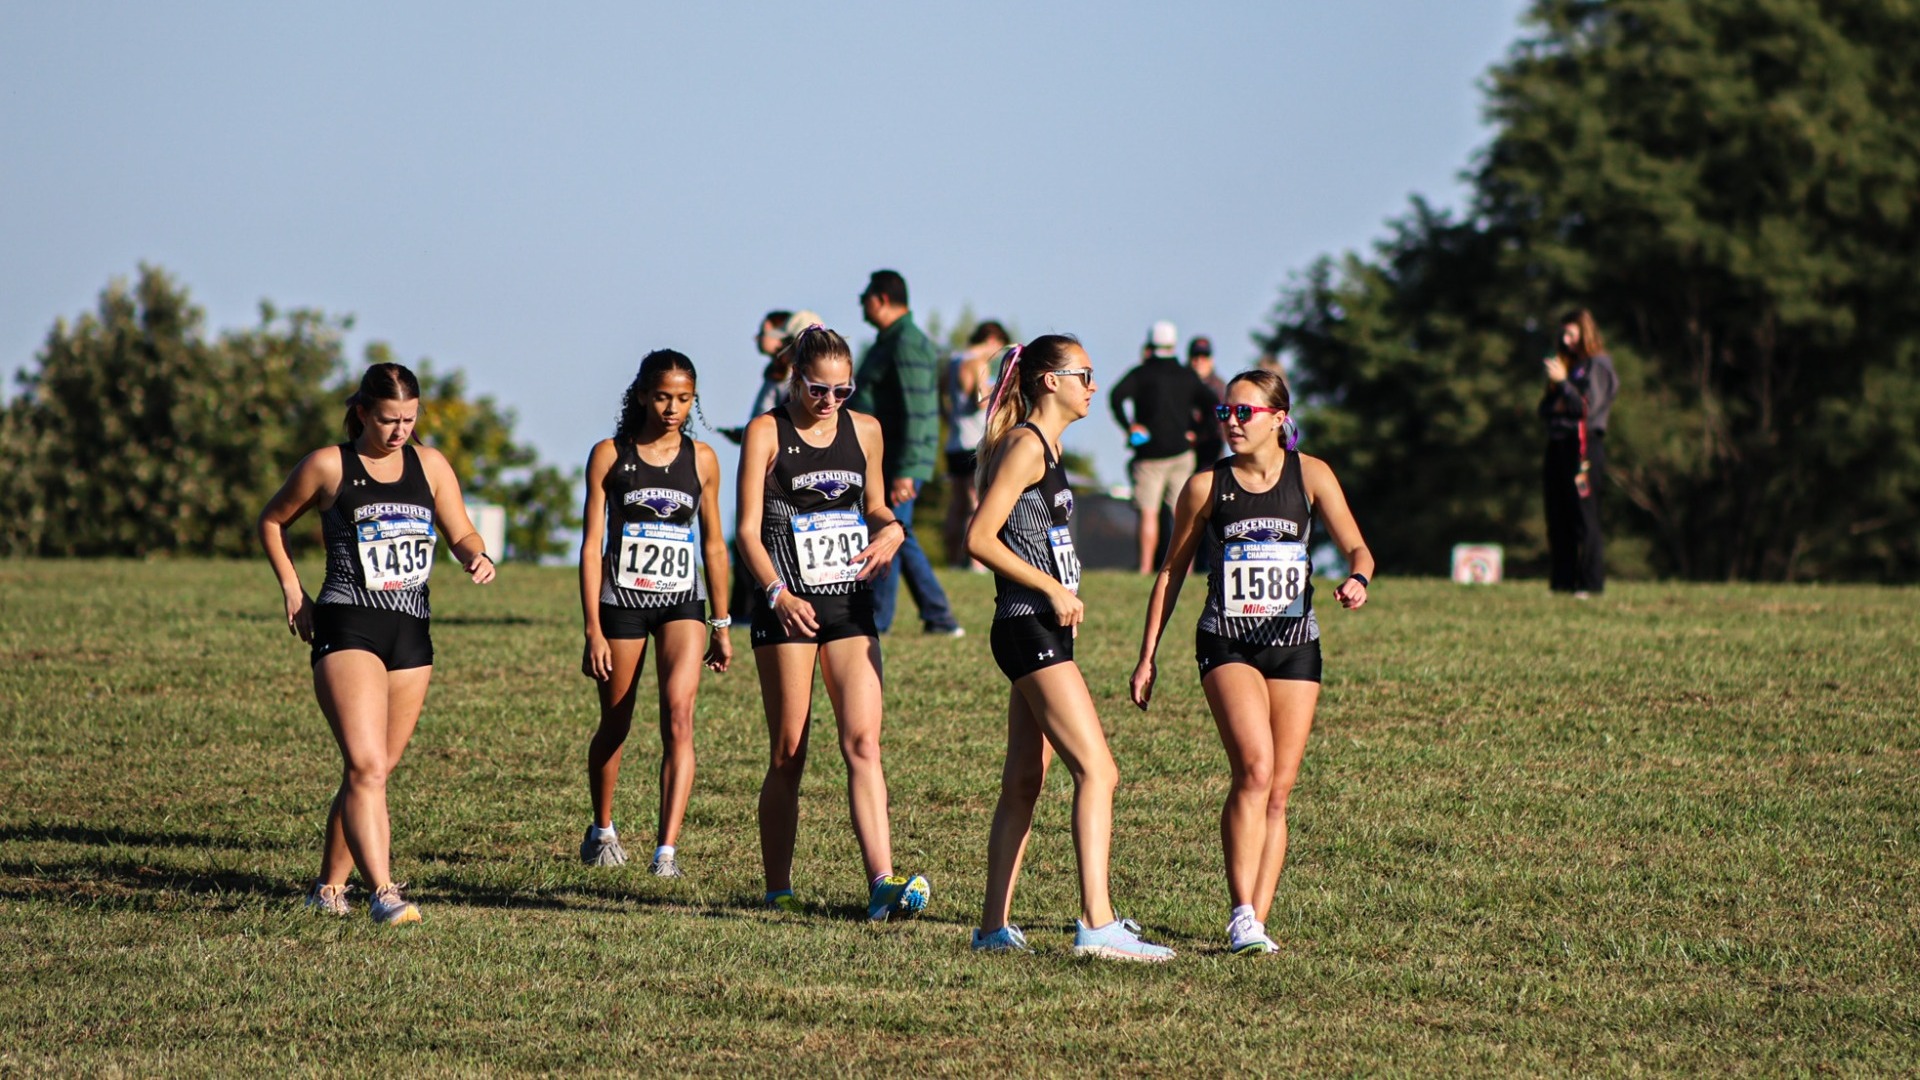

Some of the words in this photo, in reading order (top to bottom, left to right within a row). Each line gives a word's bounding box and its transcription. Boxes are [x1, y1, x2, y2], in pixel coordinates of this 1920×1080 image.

[367, 540, 429, 576] 1435
[626, 543, 689, 579] 1289
[803, 532, 864, 570] 1293
[1061, 550, 1080, 584] 143
[634, 577, 677, 591] MileSplit
[819, 569, 858, 582] eSplit
[1231, 566, 1300, 601] 1588
[1242, 604, 1288, 616] MileSplit
